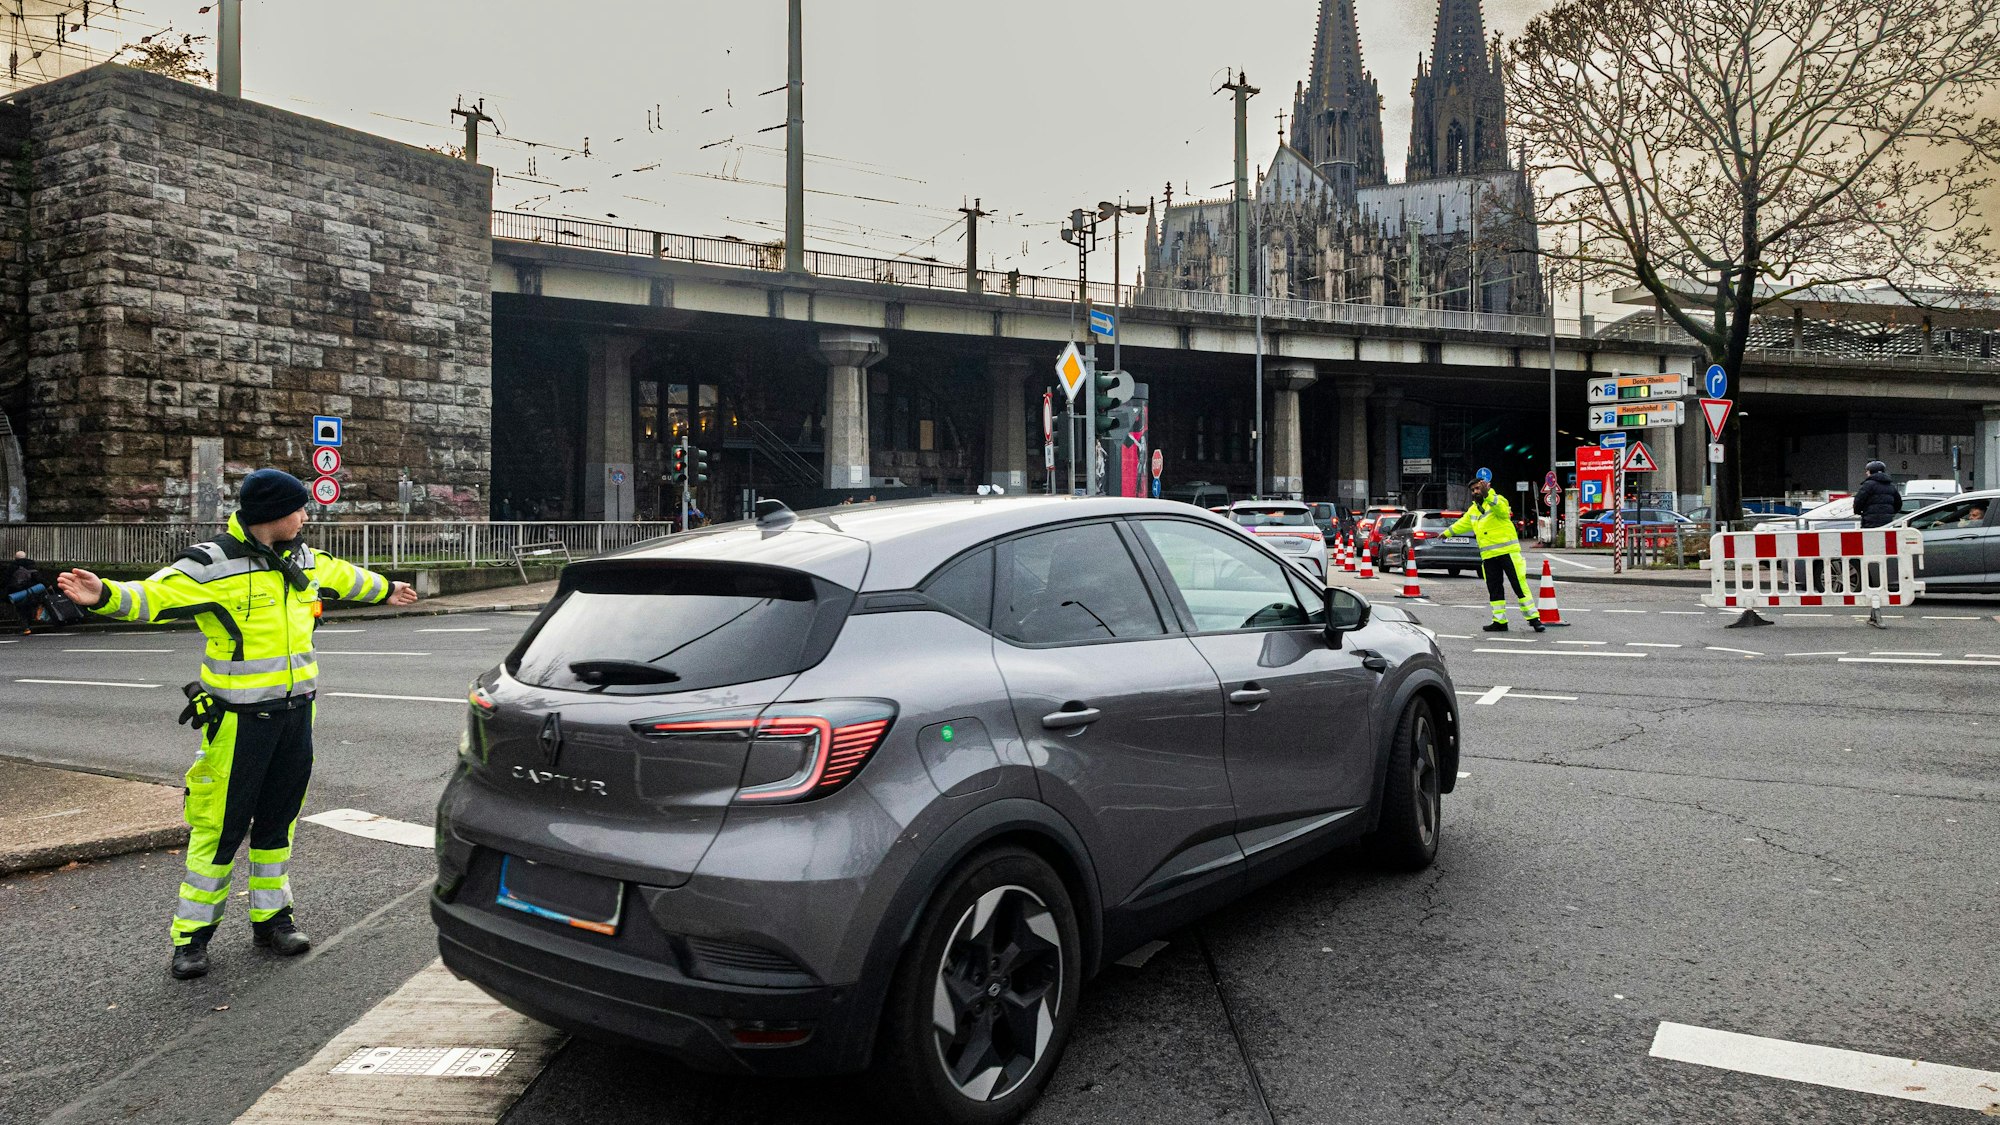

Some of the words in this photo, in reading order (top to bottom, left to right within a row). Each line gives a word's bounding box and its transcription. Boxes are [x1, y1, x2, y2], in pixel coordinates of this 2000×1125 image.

[1632, 377, 1664, 385] Dom/Rhein
[1622, 404, 1658, 413] Hauptbahnhof
[1584, 483, 1597, 502] P
[1588, 529, 1599, 542] P
[511, 765, 608, 796] CAPTUR
